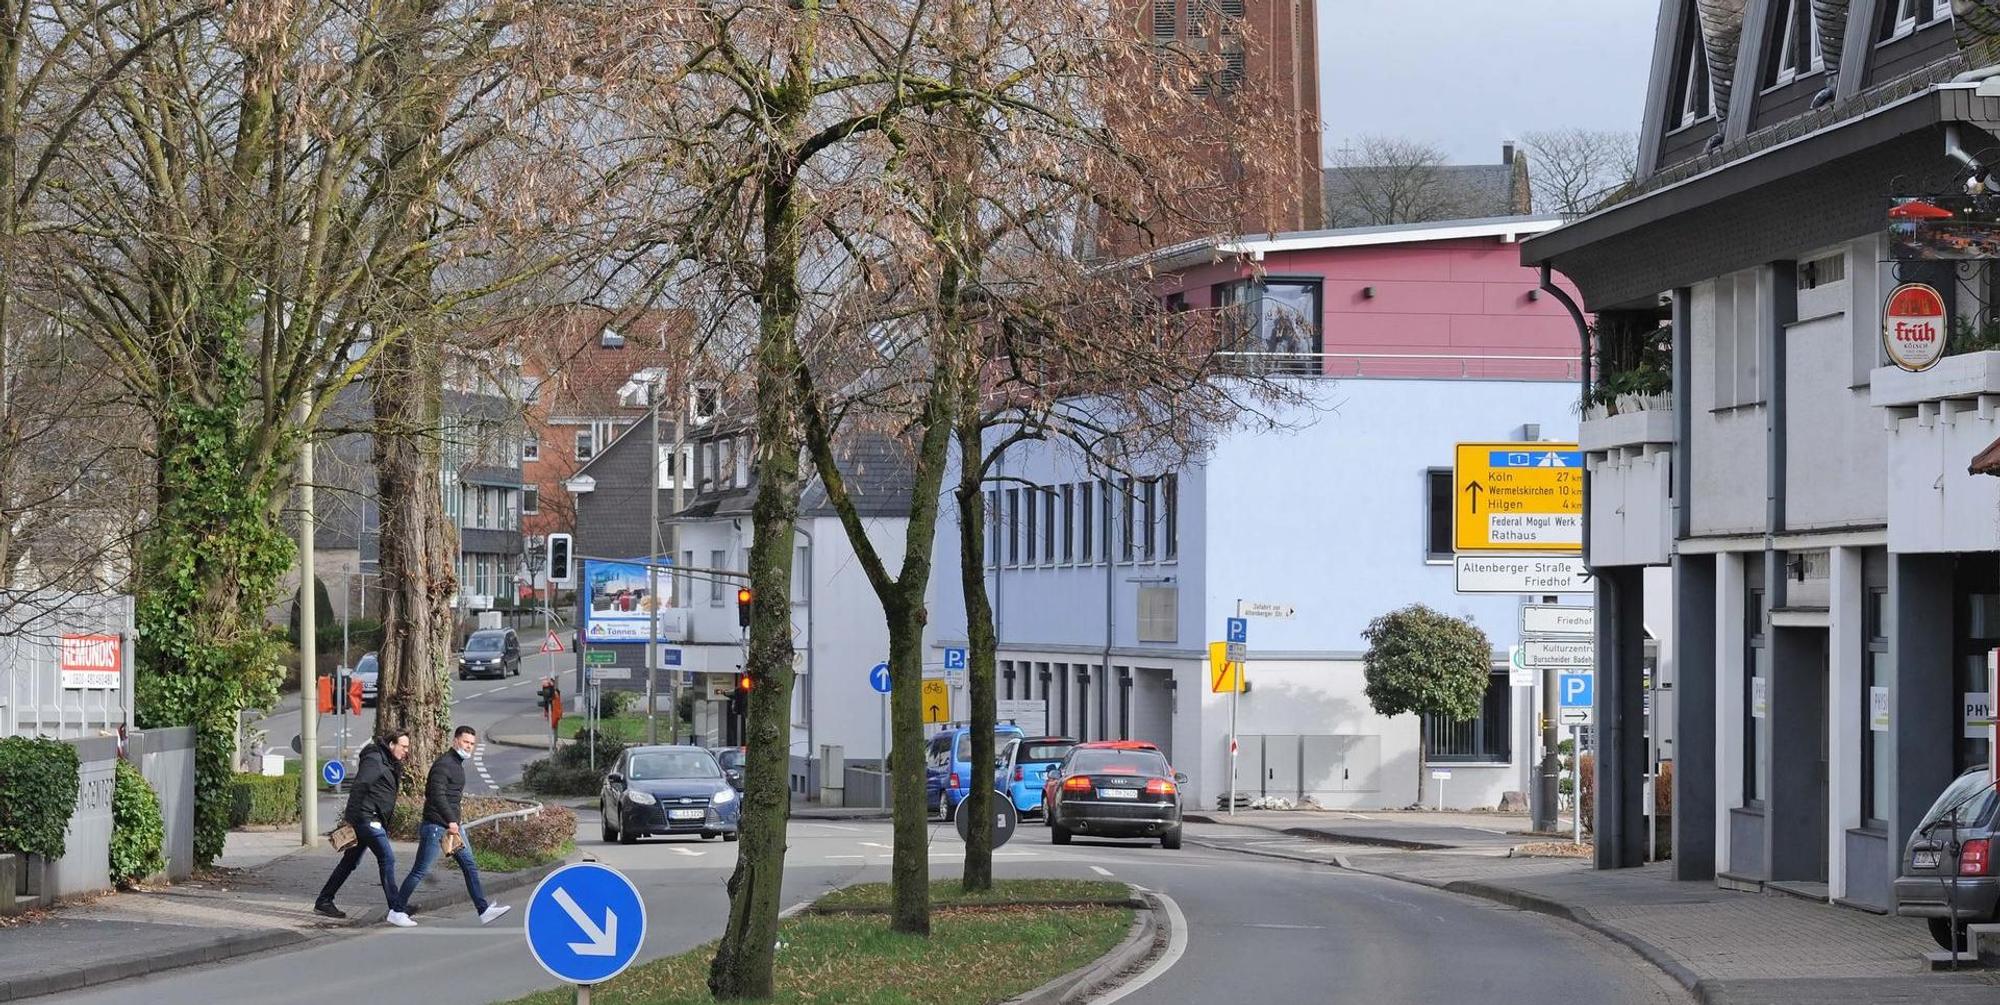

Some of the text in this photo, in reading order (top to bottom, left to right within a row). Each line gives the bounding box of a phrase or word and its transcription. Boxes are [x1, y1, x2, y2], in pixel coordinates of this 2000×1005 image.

[1895, 321, 1936, 343] früh
[1488, 471, 1513, 482] Köln
[1556, 472, 1569, 482] 27
[1489, 486, 1554, 495] Wermelskirchen
[1559, 486, 1569, 495] 10
[1488, 500, 1523, 511] Hilgen
[1562, 500, 1569, 509] 4
[1491, 516, 1522, 526] Federal
[1526, 516, 1551, 528] Mogul
[1555, 516, 1576, 526] Werk
[1491, 530, 1537, 540] Rathaus
[1463, 562, 1571, 574] Altenberger Straße
[1524, 576, 1571, 587] Friedhof
[1557, 616, 1592, 625] Friedhof
[63, 638, 115, 668] REMONDIS
[948, 650, 961, 667] P
[1567, 678, 1586, 703] P
[1967, 704, 1989, 717] PHY
